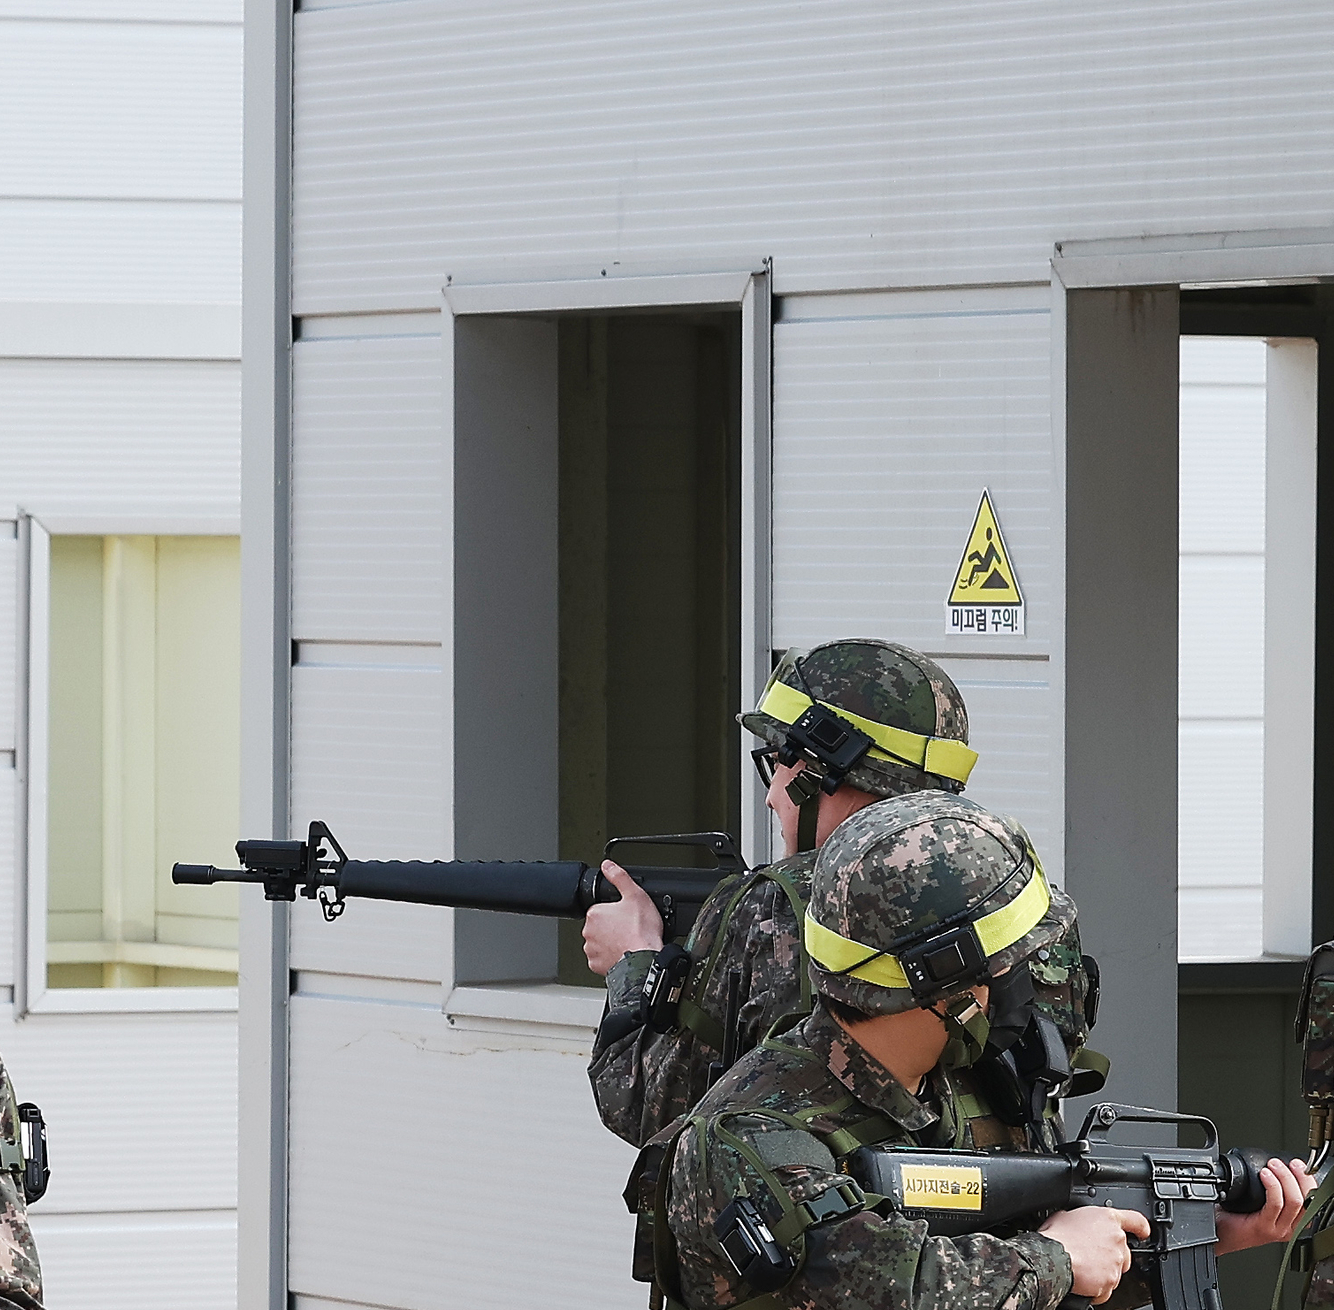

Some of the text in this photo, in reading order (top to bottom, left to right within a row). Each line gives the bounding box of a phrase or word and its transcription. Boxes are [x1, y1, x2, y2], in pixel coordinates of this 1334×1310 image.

[952, 608, 1018, 632] 미끄럼 주의!
[905, 1178, 980, 1196] 시가지전술-22
